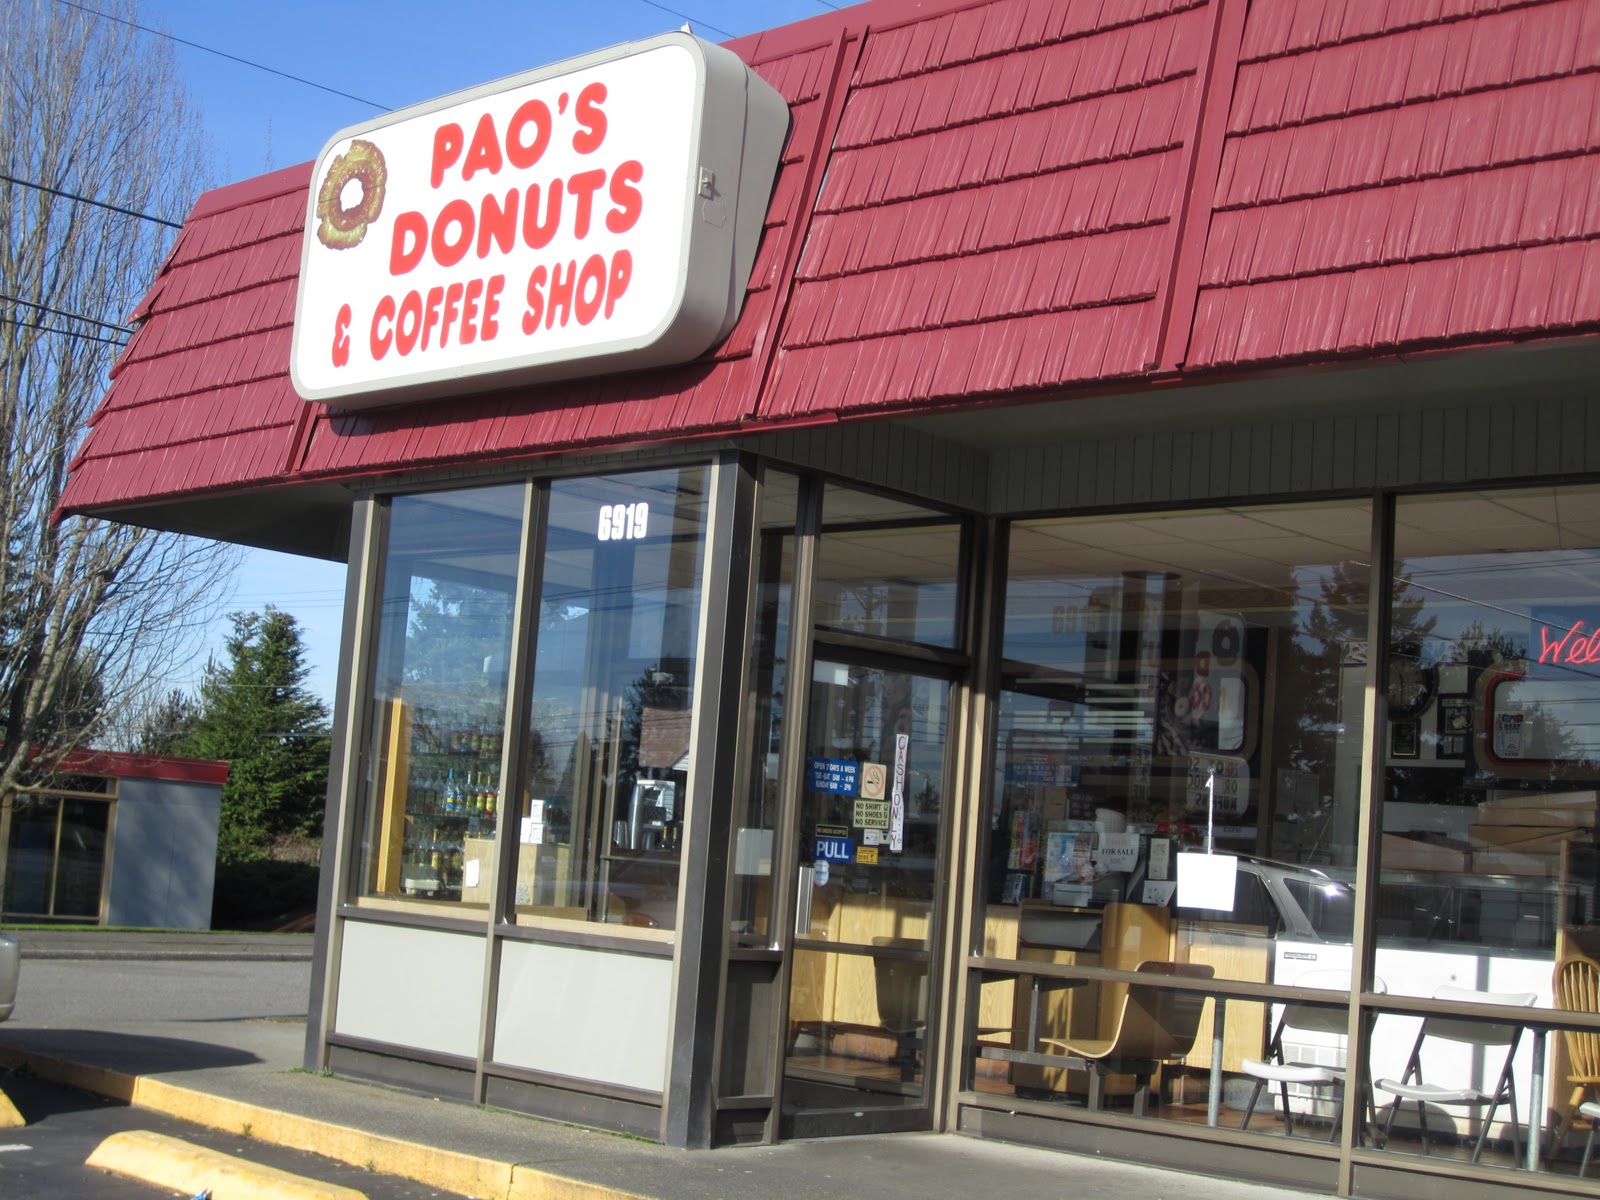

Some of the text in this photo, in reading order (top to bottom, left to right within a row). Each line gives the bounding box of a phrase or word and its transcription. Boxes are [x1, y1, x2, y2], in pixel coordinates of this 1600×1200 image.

[430, 82, 608, 189] PAO'S
[389, 160, 643, 276] DONUTS
[331, 249, 633, 368] & COFFEE SHOP
[598, 502, 649, 541] 6919
[814, 761, 825, 770] OPEN
[826, 763, 830, 771] 7
[829, 763, 840, 772] DAYS
[844, 766, 856, 774] WEEK
[896, 736, 906, 791] CASH
[864, 819, 887, 827] SERVICE
[865, 803, 882, 811] SHIRT
[891, 793, 900, 849] ONLY
[817, 841, 849, 859] PULL
[1101, 848, 1135, 856] FOR SALE
